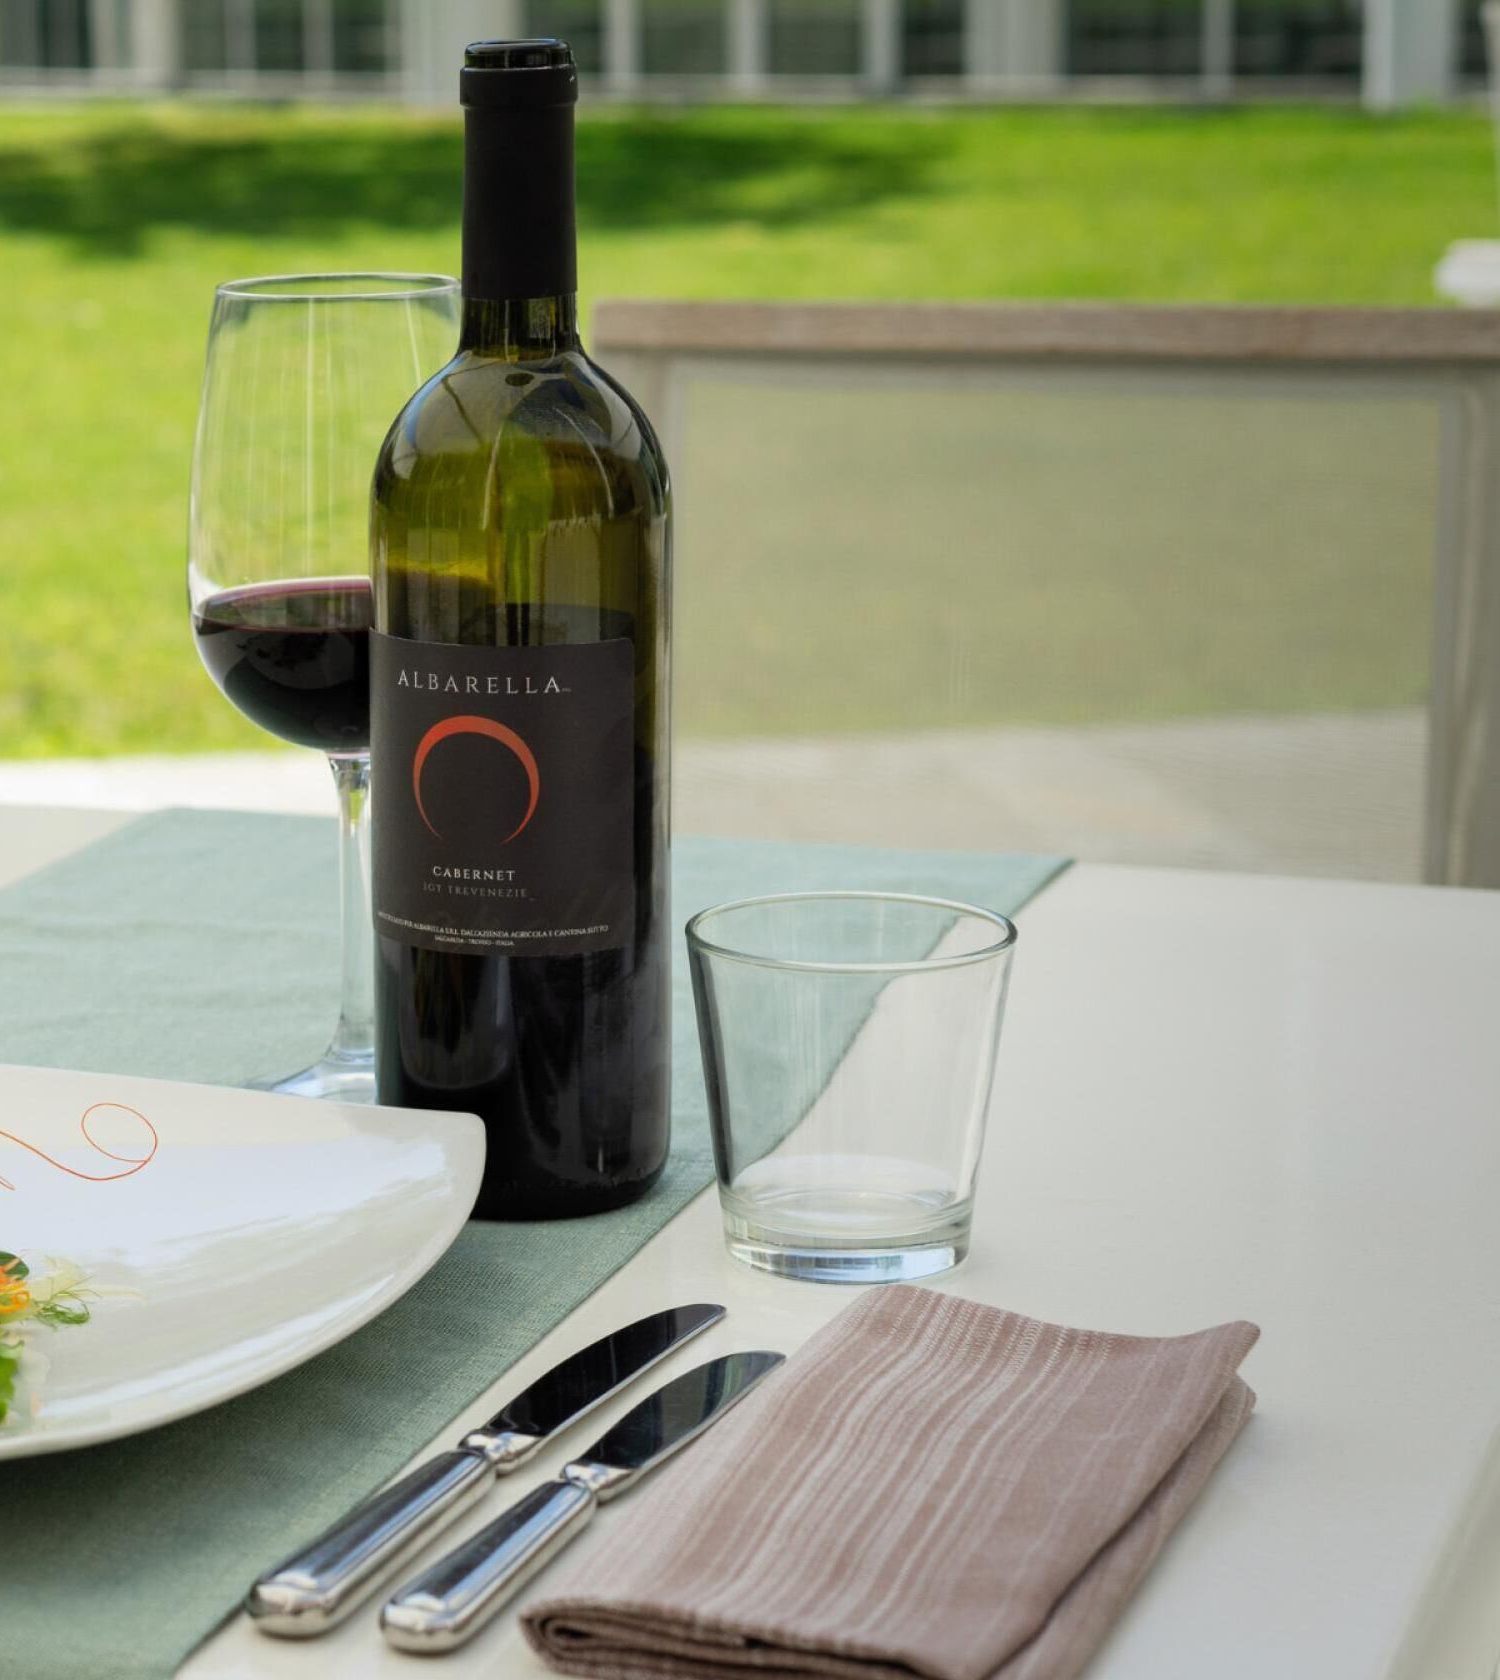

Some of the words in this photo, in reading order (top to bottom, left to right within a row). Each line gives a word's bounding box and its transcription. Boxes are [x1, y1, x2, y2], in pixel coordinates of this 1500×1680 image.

[397, 669, 561, 695] ALBARELLA
[432, 865, 516, 881] CABERNET
[448, 884, 528, 898] TREVENEZIE
[510, 930, 548, 938] AGRICOLA
[554, 928, 587, 937] CANTINA
